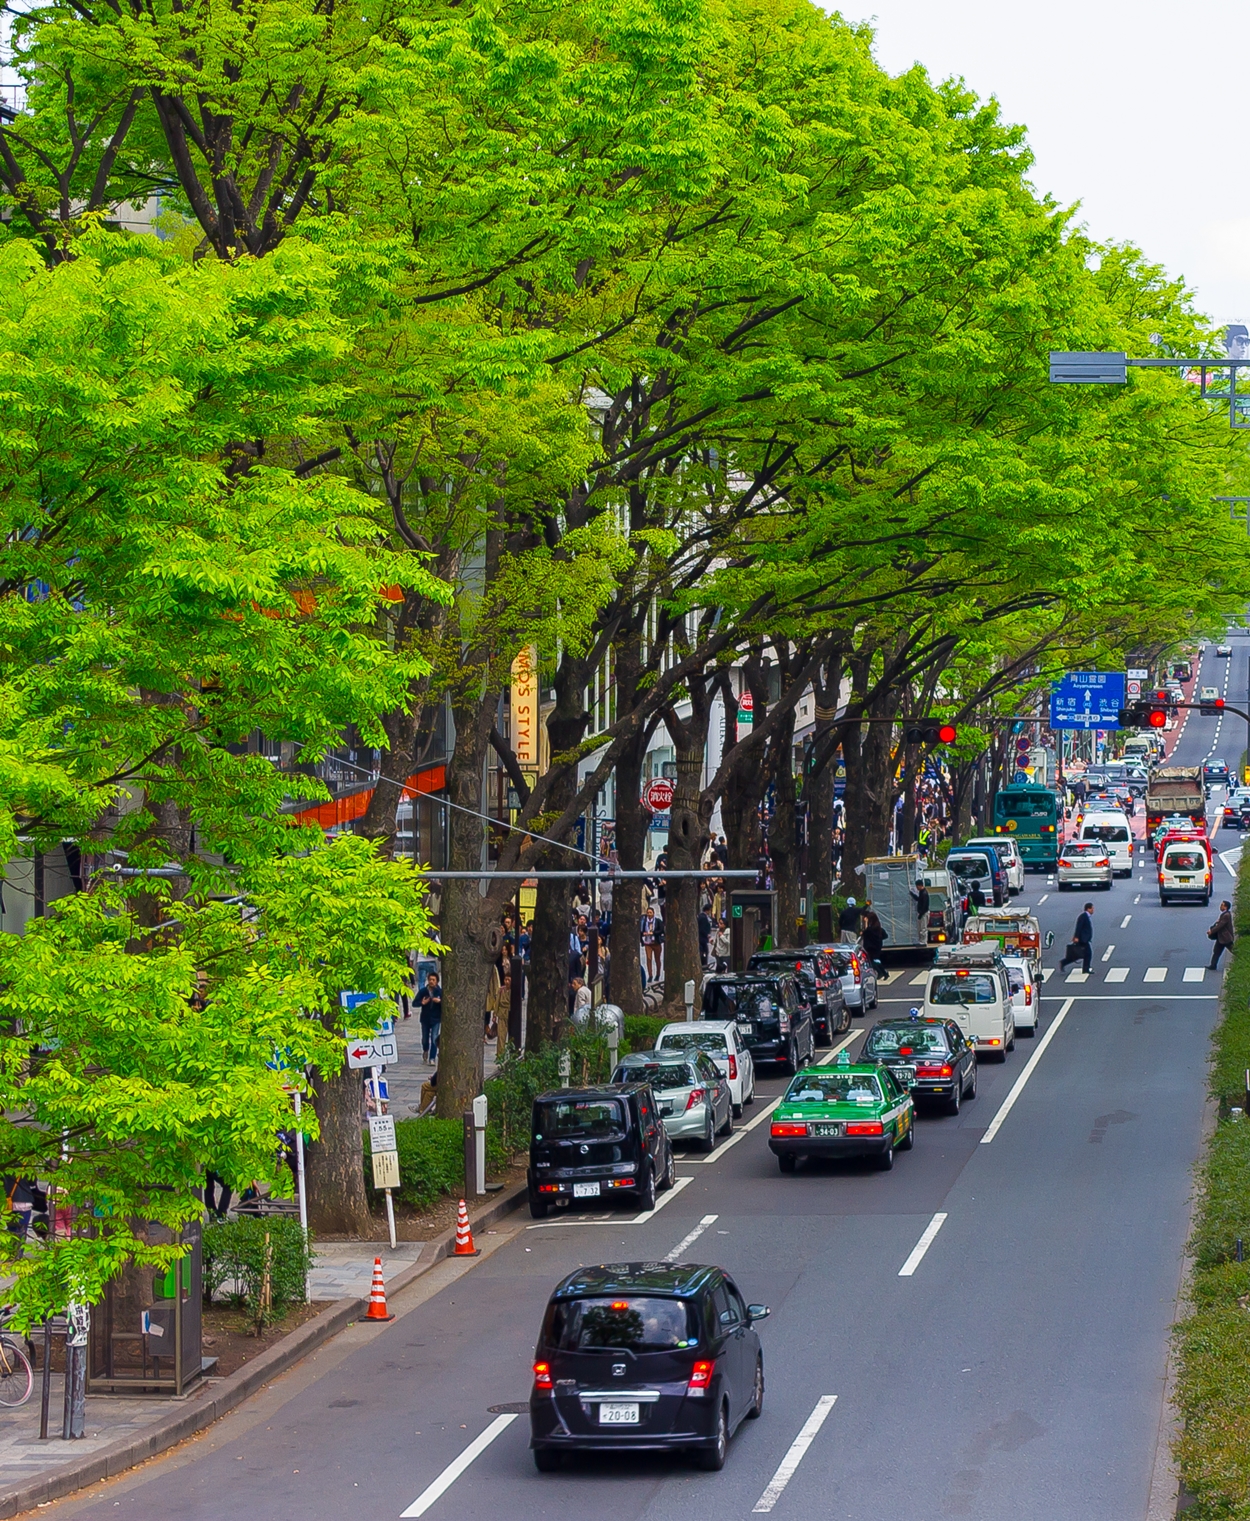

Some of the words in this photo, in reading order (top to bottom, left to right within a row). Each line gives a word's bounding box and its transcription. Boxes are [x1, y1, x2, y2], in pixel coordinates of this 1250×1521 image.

[1056, 698, 1076, 707] 新宿
[1099, 698, 1119, 707] 渋谷
[517, 705, 531, 760] STYLE
[650, 791, 673, 803] 消火栓
[368, 1043, 394, 1059] 入口
